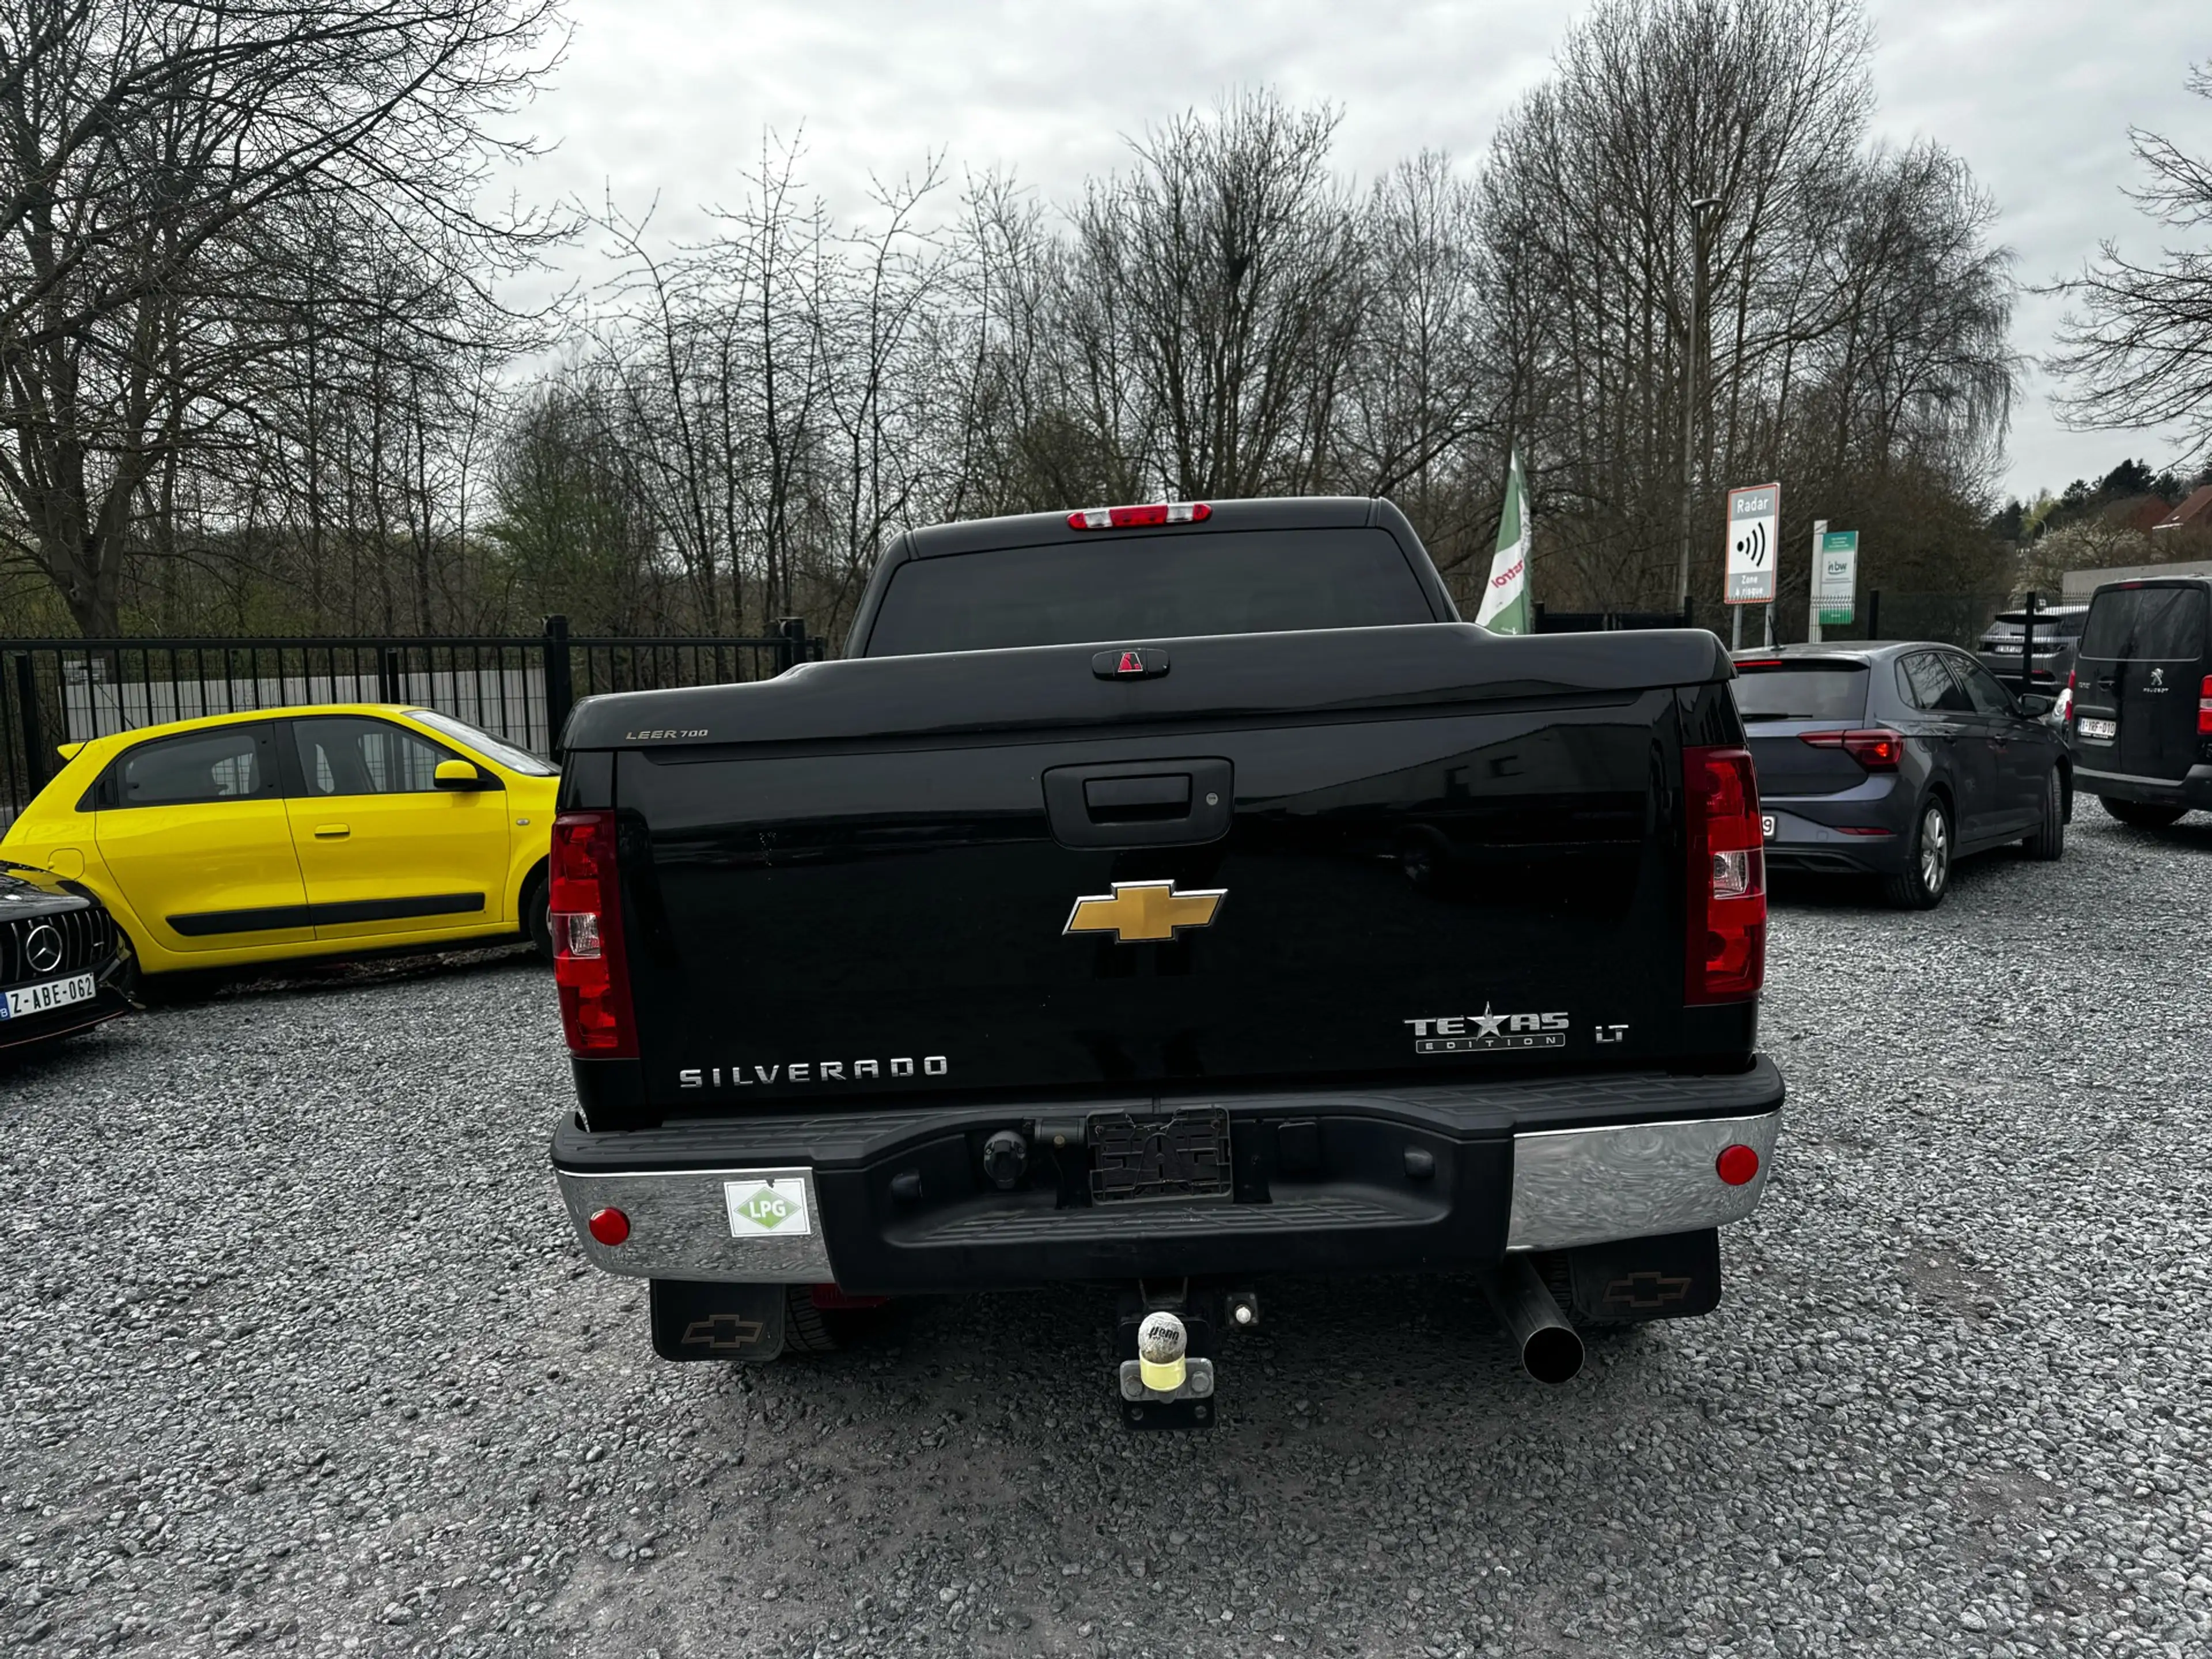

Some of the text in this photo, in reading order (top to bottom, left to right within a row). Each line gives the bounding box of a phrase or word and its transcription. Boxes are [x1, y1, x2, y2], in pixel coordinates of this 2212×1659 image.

[1737, 496, 1770, 513] Radar
[1741, 575, 1759, 585] Zone
[626, 729, 709, 740] LEER 700
[10, 977, 93, 1014] Z-ABE-062
[1425, 1036, 1556, 1050] EDITION
[1595, 1024, 1629, 1044] LT
[680, 1056, 948, 1088] SILVERADO
[749, 1199, 787, 1218] LPG
